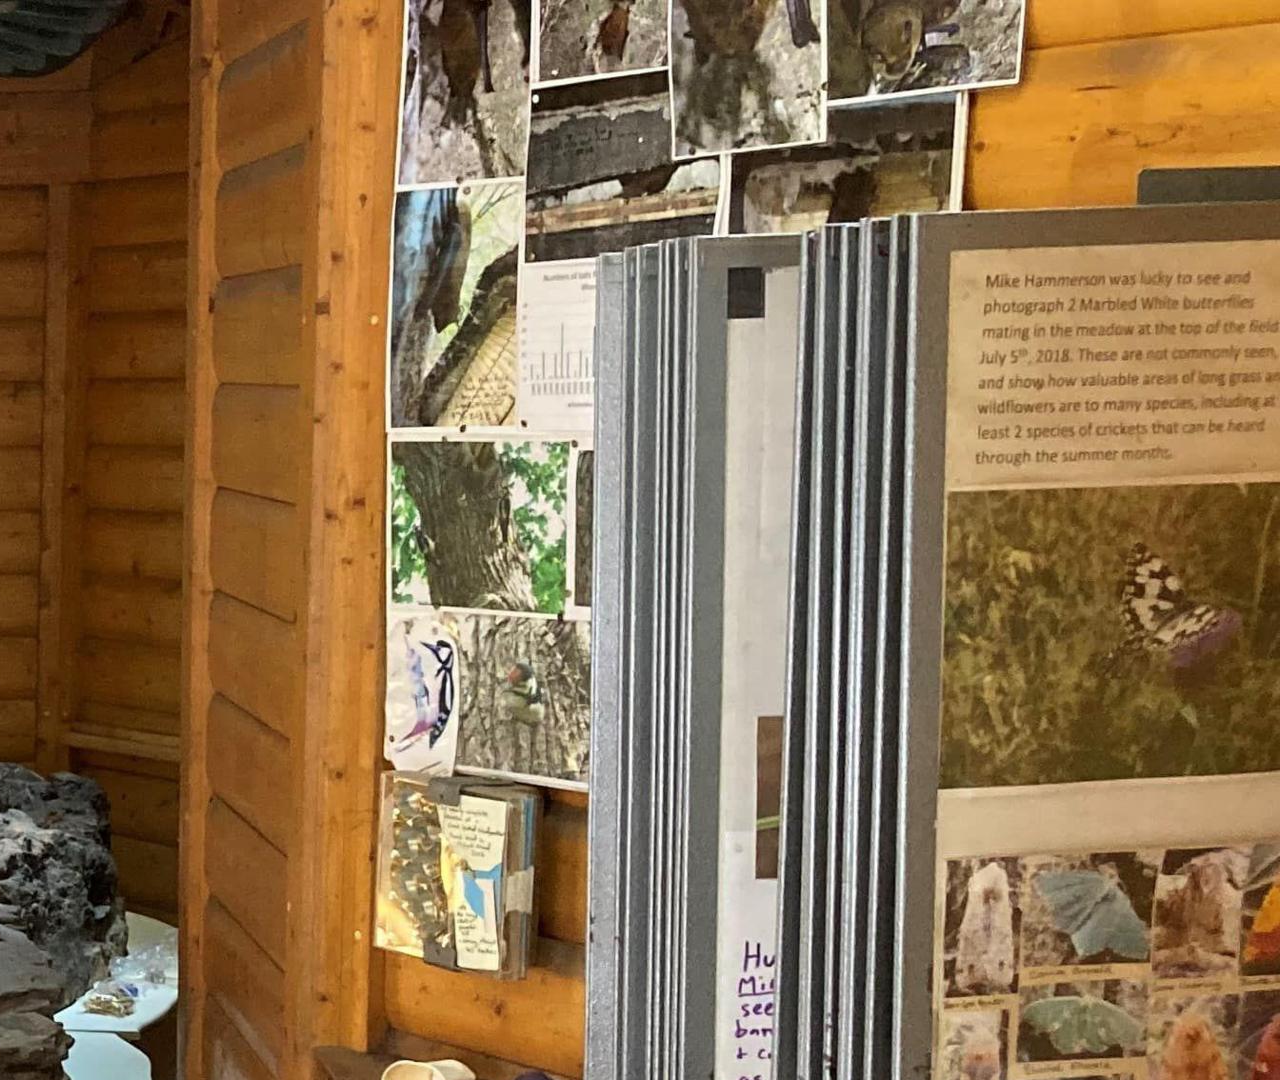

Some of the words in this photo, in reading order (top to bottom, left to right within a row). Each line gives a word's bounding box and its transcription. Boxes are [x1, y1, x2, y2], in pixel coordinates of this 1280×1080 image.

[985, 273, 1020, 287] Mike
[1024, 271, 1105, 287] Hammerson
[1109, 274, 1136, 285] was
[1139, 270, 1172, 289] lucky
[1176, 271, 1192, 284] to
[1196, 273, 1220, 284] see
[1224, 269, 1251, 284] and
[983, 297, 1064, 317] photograph
[1067, 297, 1076, 311] 2
[1078, 296, 1137, 311] Marbled
[982, 323, 1030, 342] mating
[1032, 323, 1046, 337] in
[1049, 322, 1073, 337] the
[1075, 321, 1134, 336] meadow
[1154, 321, 1176, 335] the
[1179, 321, 1202, 339] top
[1205, 320, 1220, 334] of
[1222, 320, 1245, 334] the
[979, 348, 1006, 367] July
[1078, 347, 1118, 361] These
[1121, 350, 1143, 361] are
[1145, 347, 1168, 360] not
[1171, 345, 1240, 364] commonly
[978, 373, 1004, 387] and
[1046, 372, 1076, 386] how
[1080, 371, 1139, 386] valuable
[1181, 370, 1194, 385] of
[977, 398, 1055, 413] wildflowers
[1058, 401, 1081, 412] are
[1084, 398, 1099, 412] to
[1102, 400, 1141, 416] many
[977, 424, 1010, 438] least
[1014, 423, 1022, 438] 2
[1026, 423, 1075, 442] species
[1078, 422, 1092, 437] of
[1095, 421, 1147, 436] crickets
[1151, 420, 1179, 435] that
[1181, 423, 1205, 434] can
[1207, 419, 1224, 434] be
[1226, 419, 1265, 434] heard
[974, 447, 1031, 467] through
[1035, 447, 1058, 462] the
[1061, 450, 1118, 461] summer
